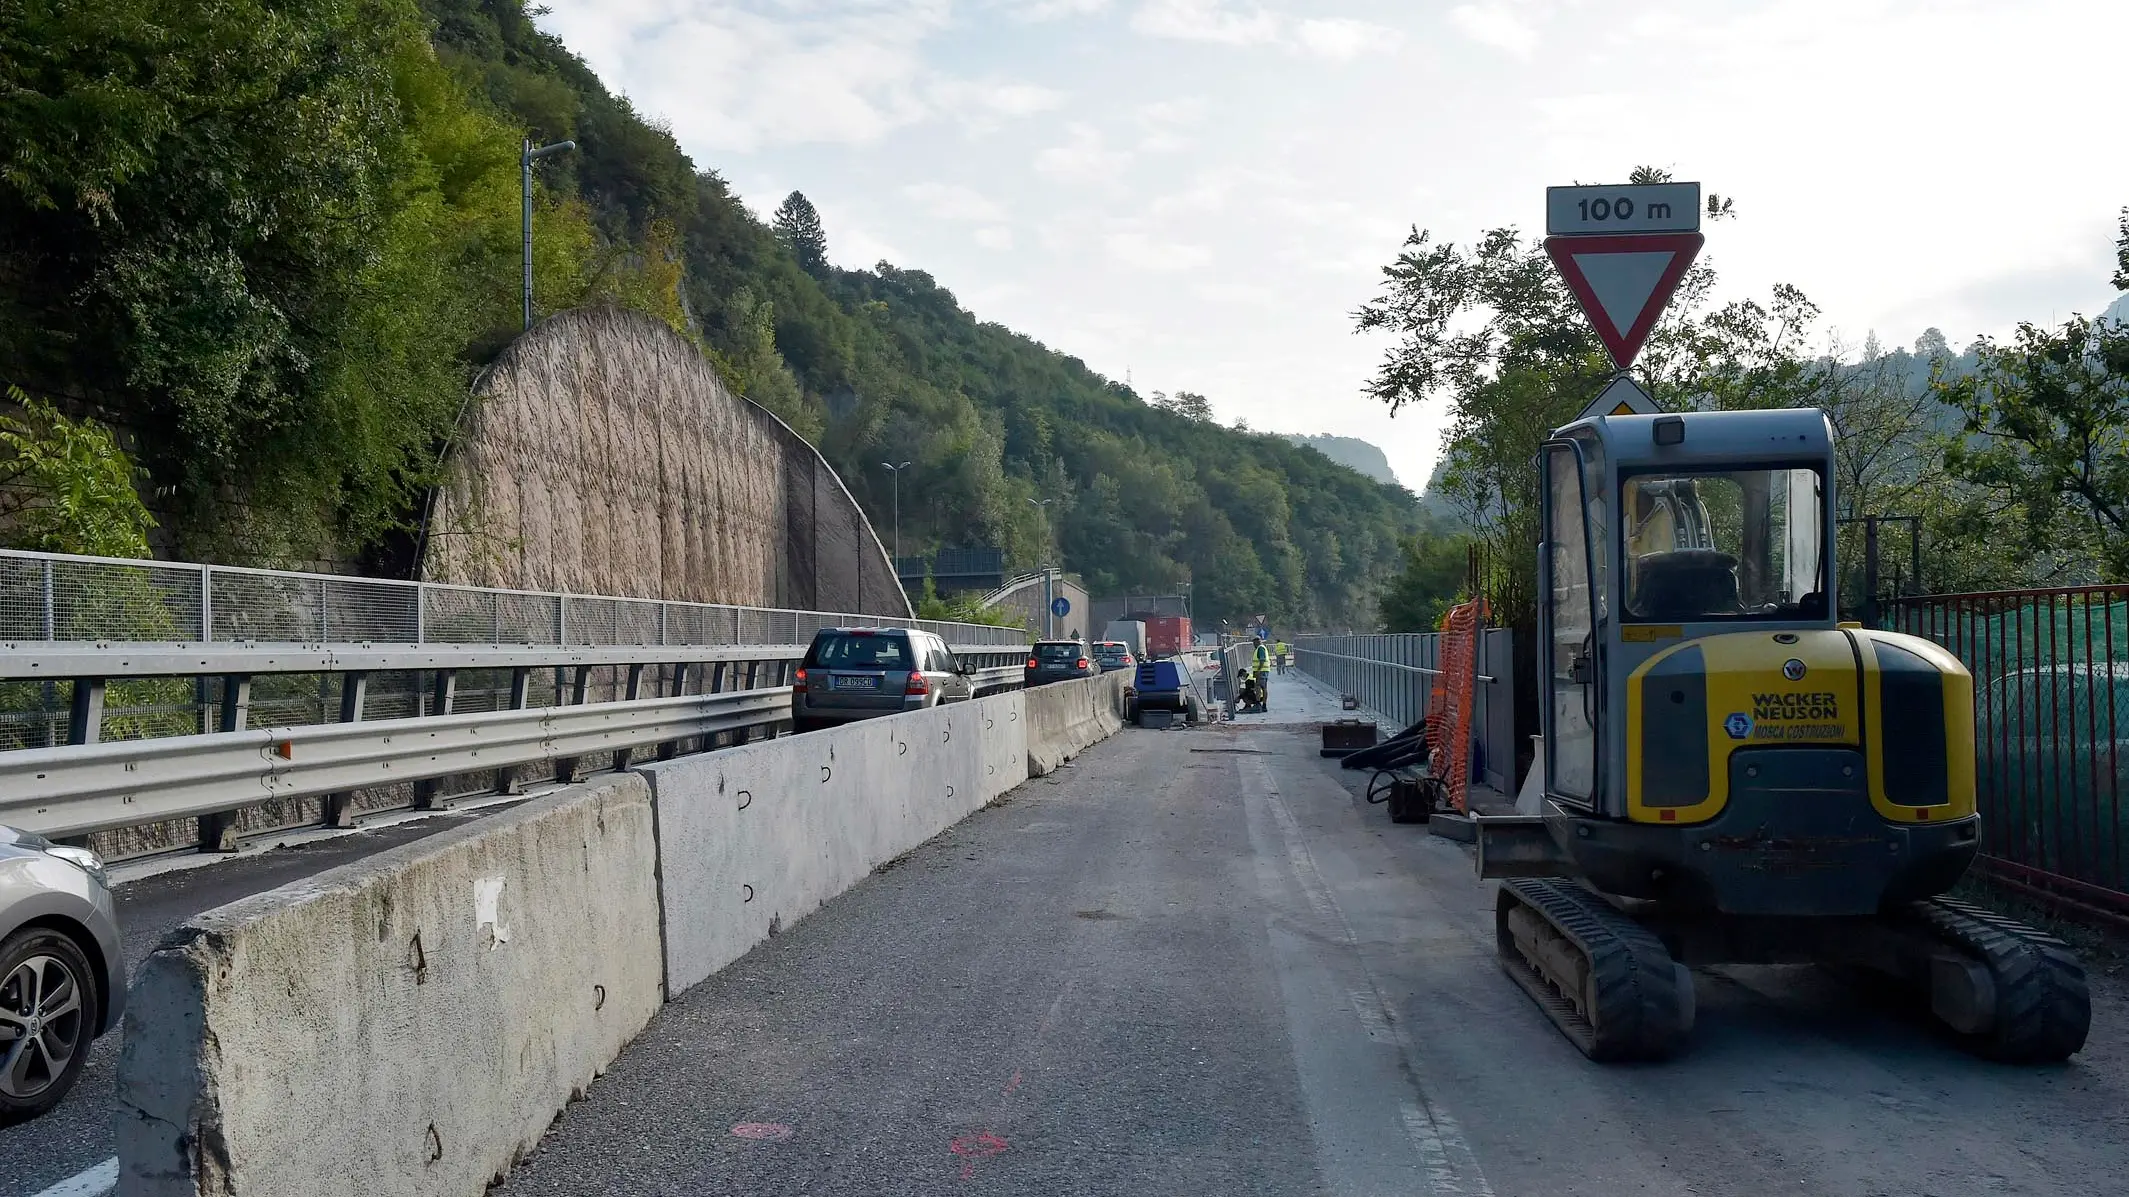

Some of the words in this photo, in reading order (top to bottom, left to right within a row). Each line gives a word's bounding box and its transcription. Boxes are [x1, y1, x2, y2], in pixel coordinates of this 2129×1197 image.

[1578, 197, 1634, 221] 100
[1647, 202, 1671, 219] m
[1752, 692, 1836, 706] WACKER
[1753, 707, 1838, 720] NEUSON
[1754, 724, 1785, 738] MOSCA
[1786, 724, 1845, 739] COSTRUZIONI
